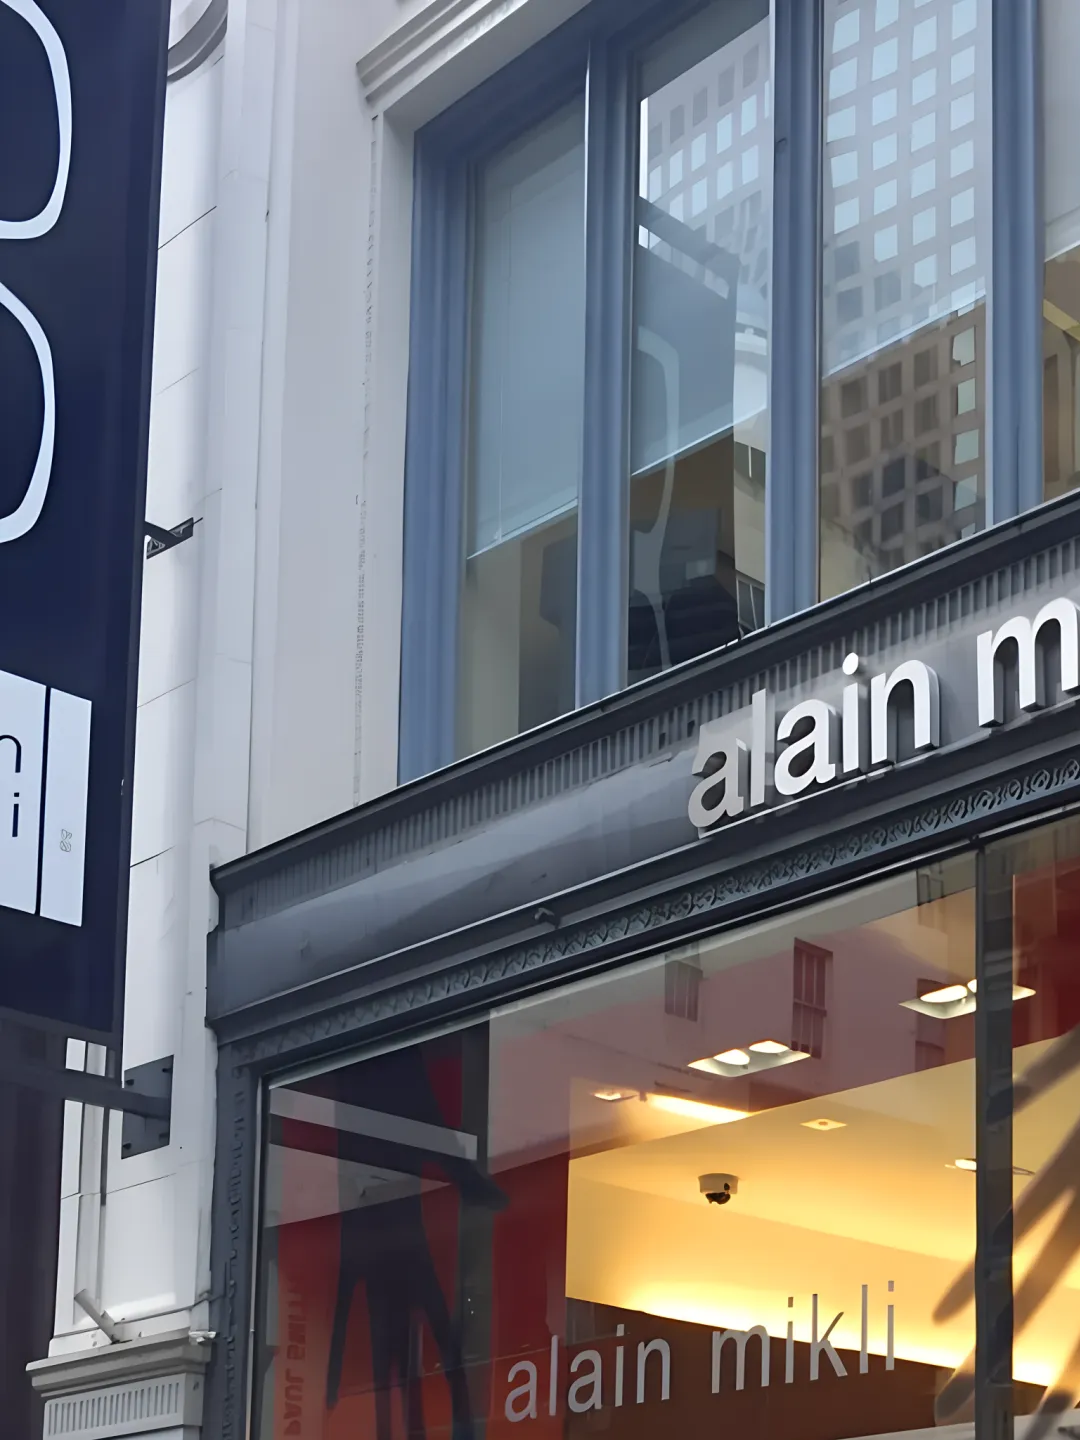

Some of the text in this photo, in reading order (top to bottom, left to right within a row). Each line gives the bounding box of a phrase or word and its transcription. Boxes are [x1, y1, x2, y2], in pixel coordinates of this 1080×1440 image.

[688, 652, 937, 828] alain
[504, 1280, 895, 1422] alain mikli
